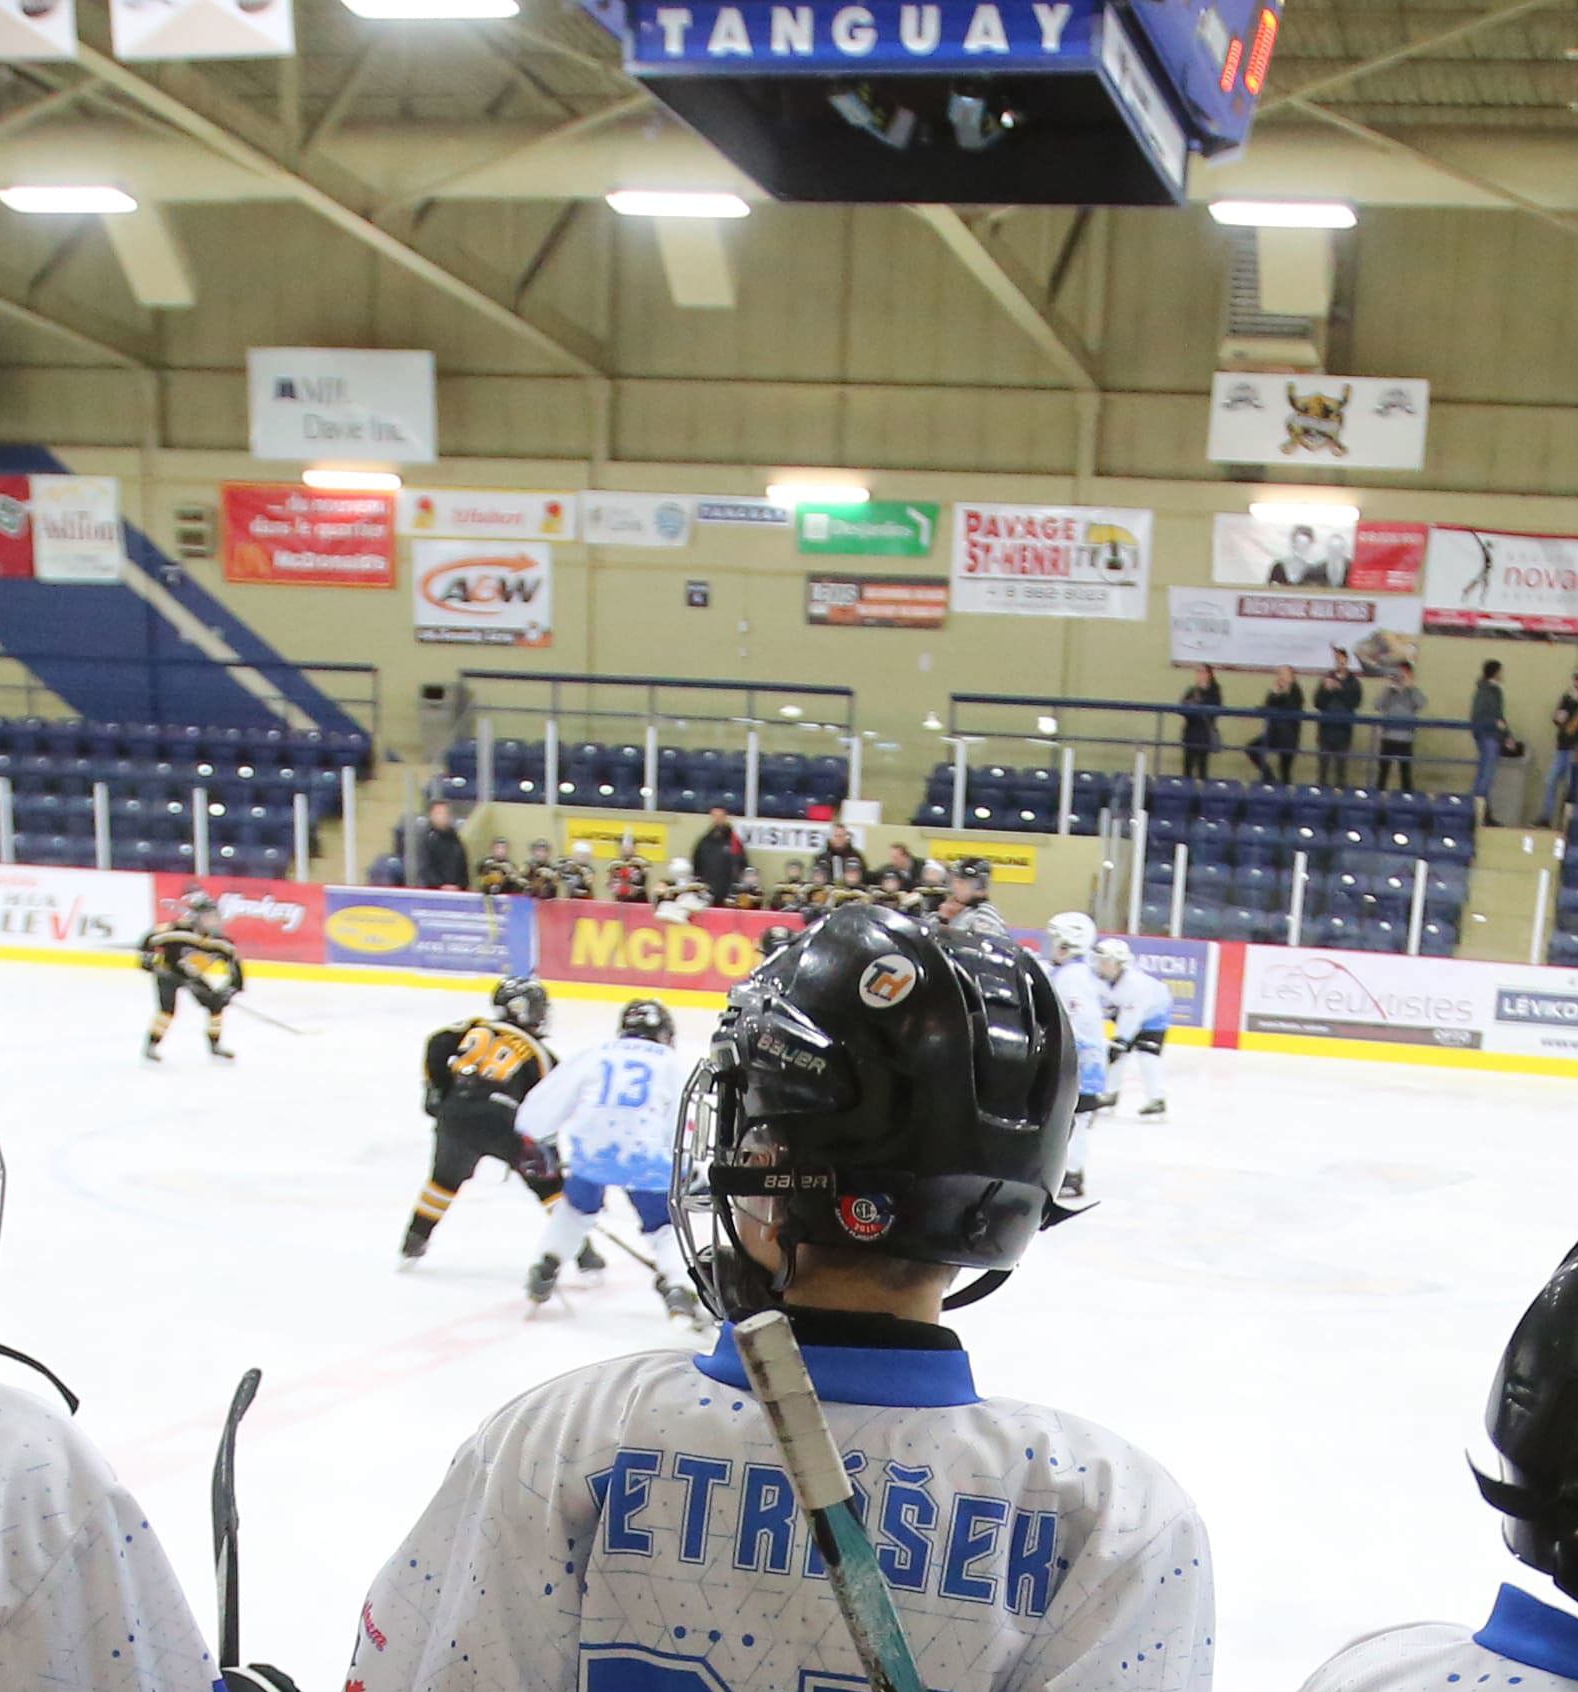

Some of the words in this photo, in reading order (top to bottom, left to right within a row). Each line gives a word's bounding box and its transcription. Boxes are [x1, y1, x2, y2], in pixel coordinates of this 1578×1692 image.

[657, 4, 1074, 57] TANGUAY
[965, 509, 1078, 541] PAVAGE
[965, 540, 1072, 577] ST-HENRI
[441, 576, 542, 603] A&W
[1260, 980, 1303, 1002] Les
[757, 1033, 827, 1075] BAUER
[598, 1059, 653, 1108] 13
[763, 1174, 829, 1189] BAER
[587, 1447, 1060, 1618] ETRŠEK
